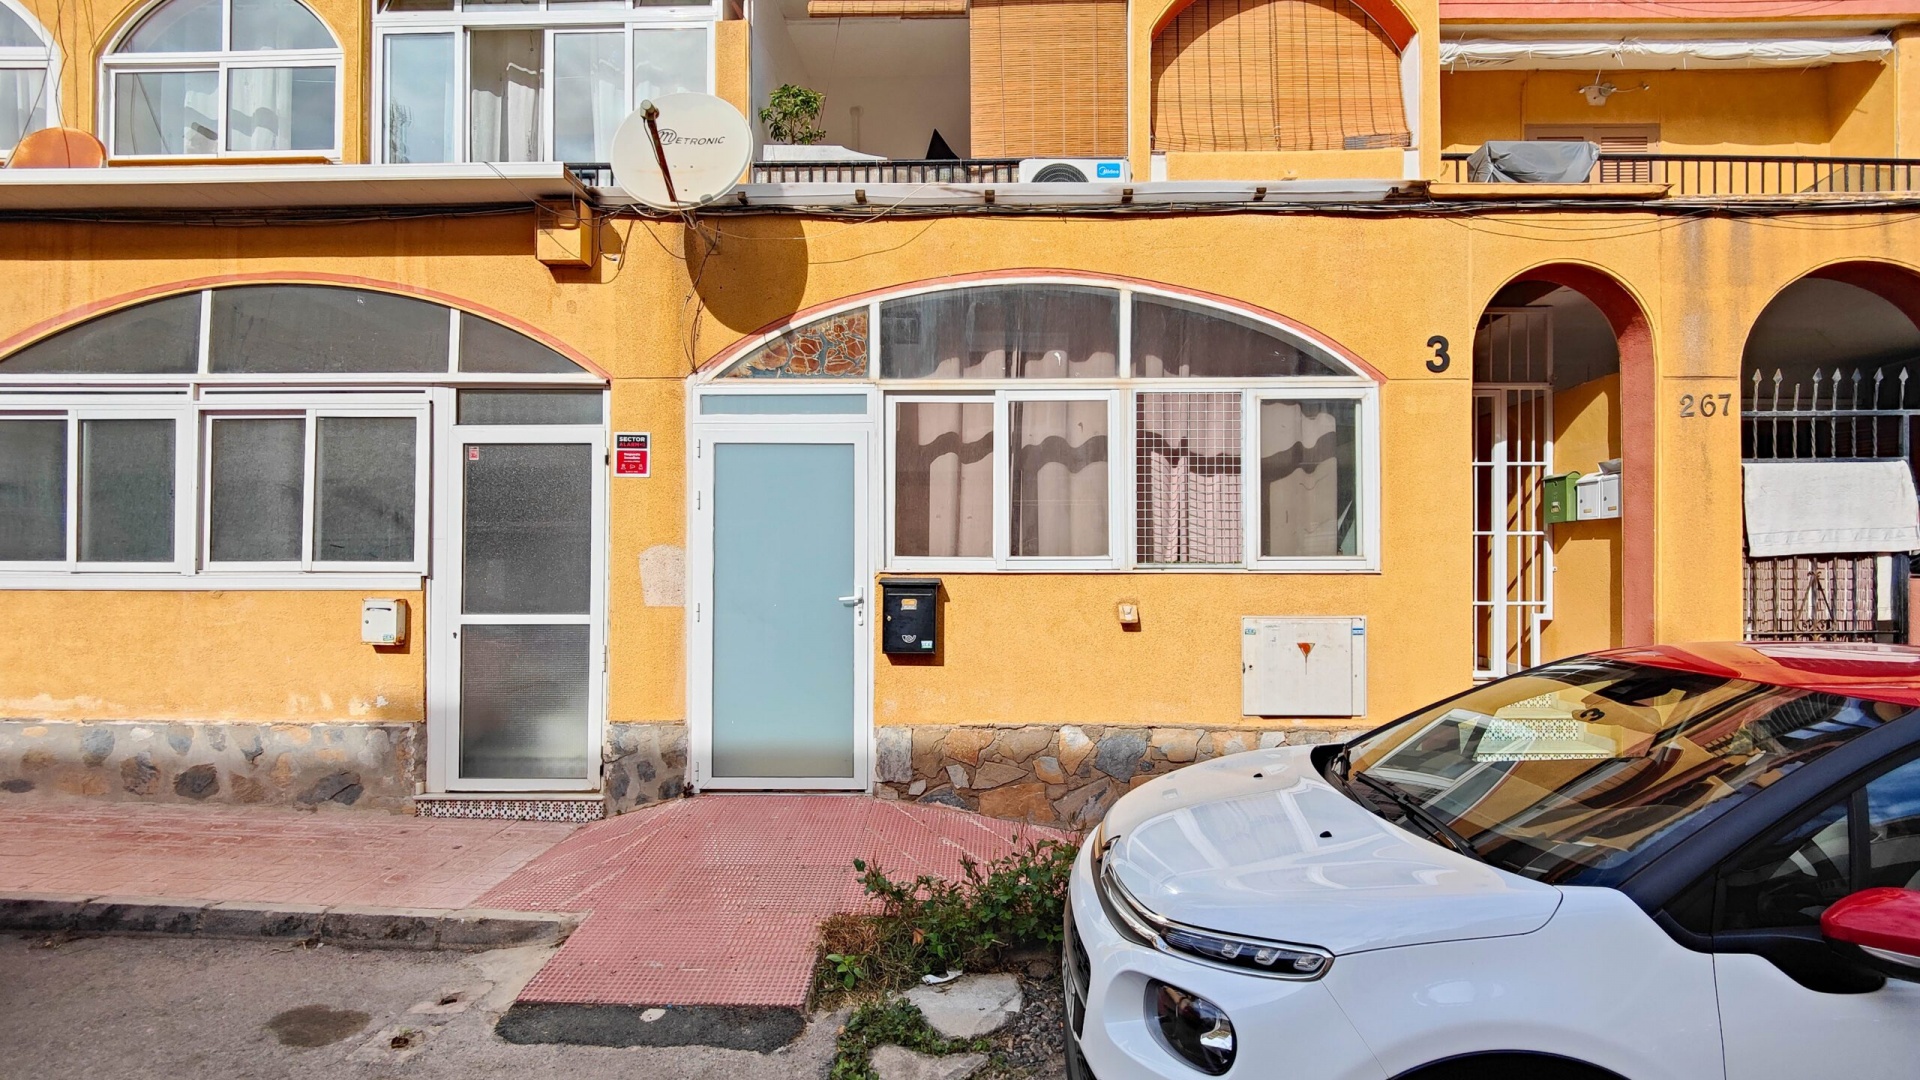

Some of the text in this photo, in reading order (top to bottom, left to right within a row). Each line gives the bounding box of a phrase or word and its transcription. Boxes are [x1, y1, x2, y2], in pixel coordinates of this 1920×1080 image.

[658, 129, 725, 145] METRONIC
[1425, 335, 1450, 373] 3
[1679, 393, 1732, 418] 267
